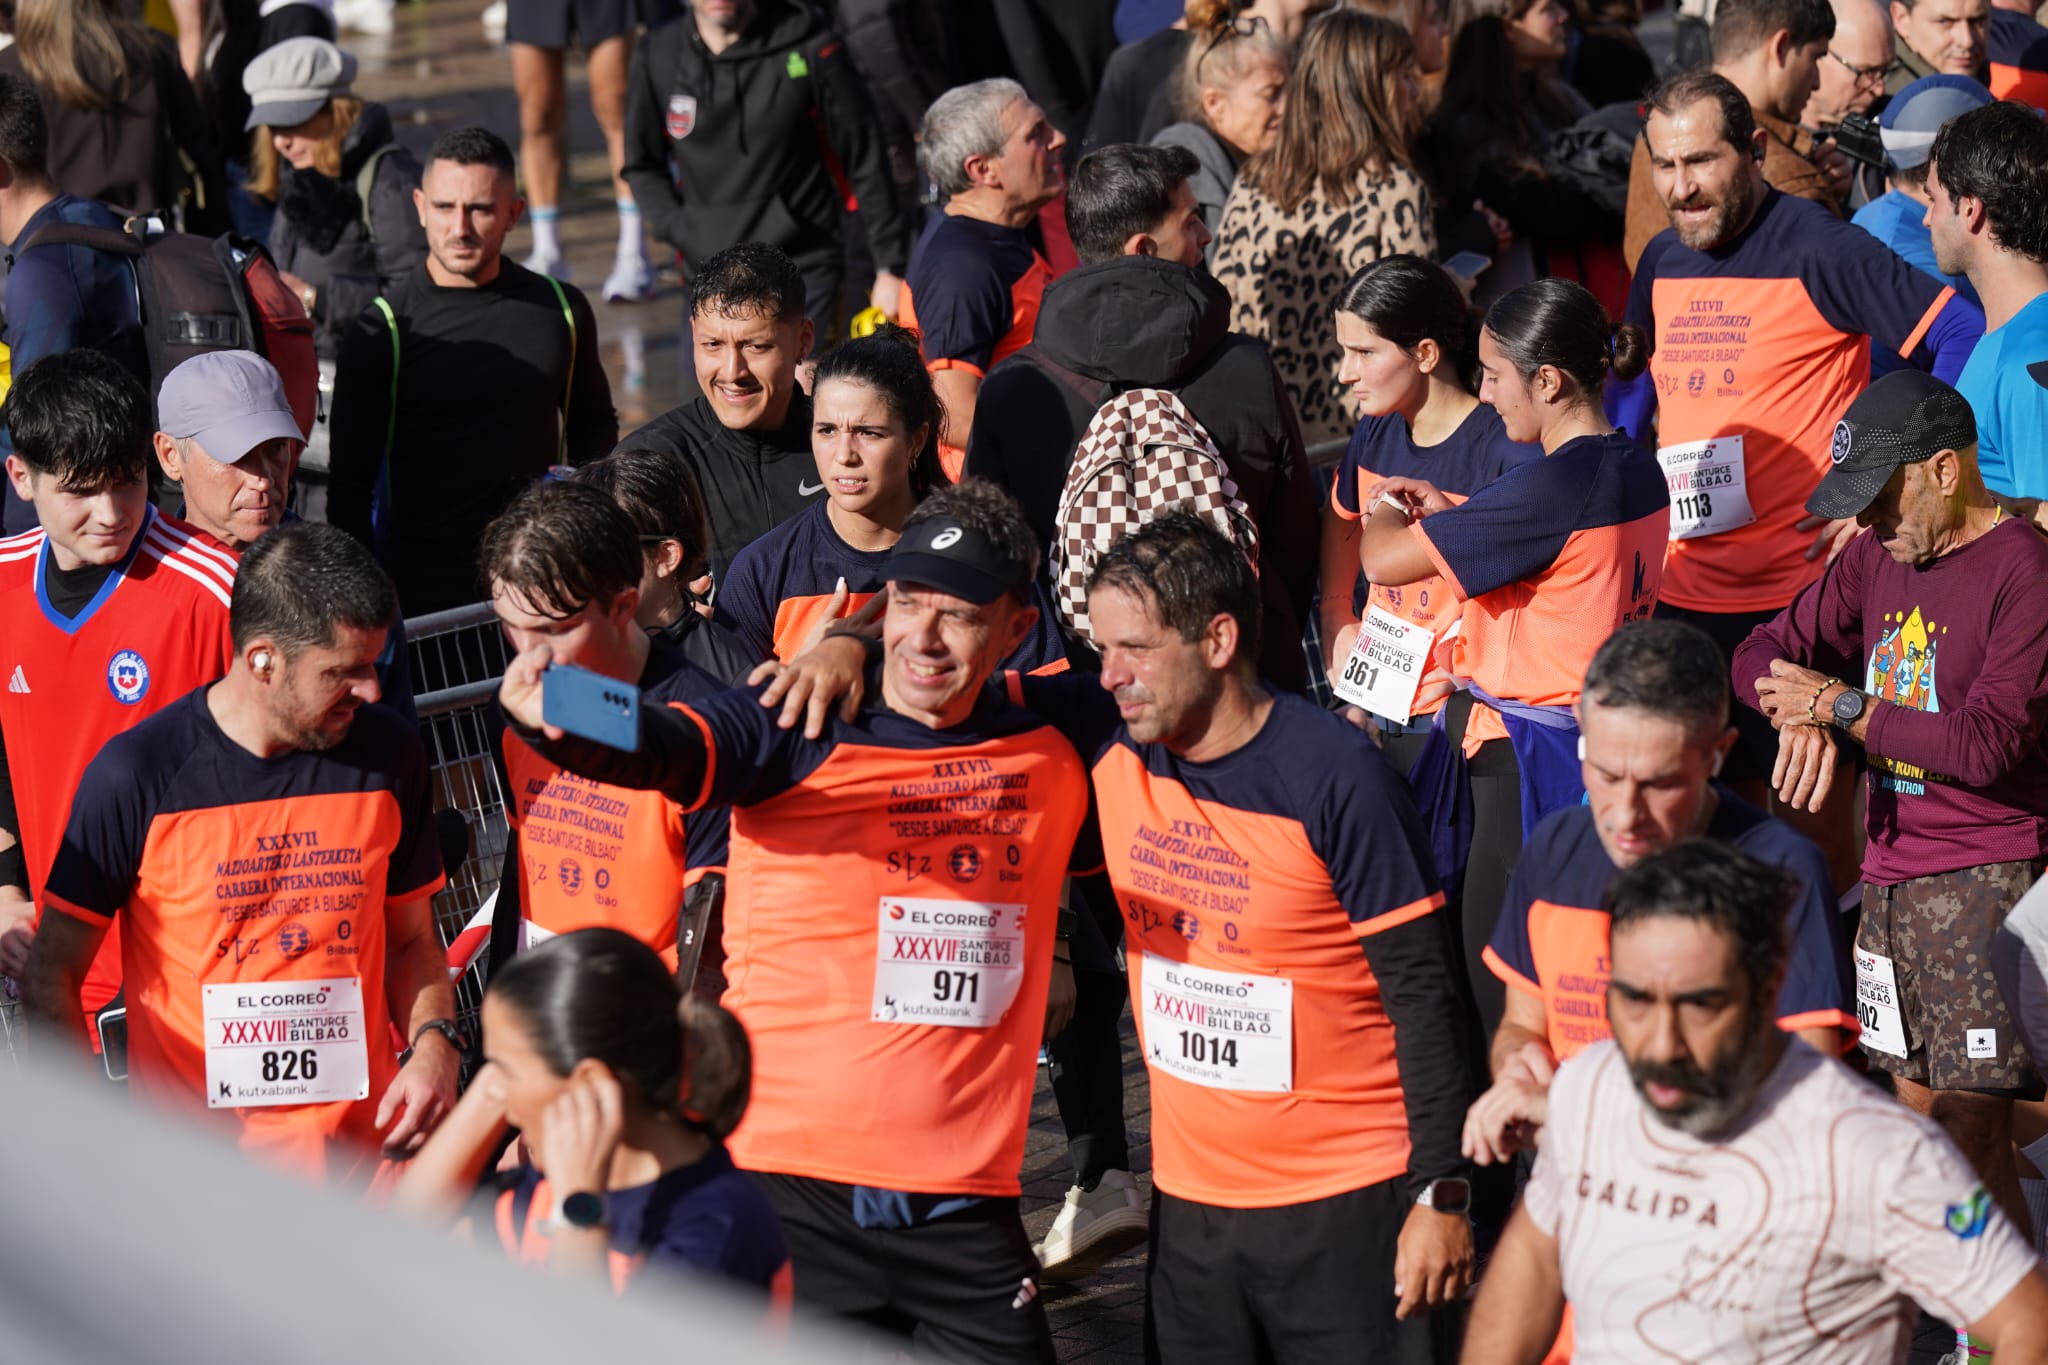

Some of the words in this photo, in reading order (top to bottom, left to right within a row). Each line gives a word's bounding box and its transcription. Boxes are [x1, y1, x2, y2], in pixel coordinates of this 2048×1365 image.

[1673, 449, 1713, 464] CORREO
[1689, 465, 1731, 479] SANTURCE
[1690, 474, 1732, 489] BILBAO
[1677, 492, 1712, 521] 1113
[1368, 615, 1404, 639] CORREO
[1368, 647, 1412, 673] BILBAO
[1371, 639, 1415, 664] SANTURCE
[1344, 656, 1379, 691] 361
[932, 759, 993, 778] XXXVII
[890, 779, 970, 799] NAZIOARTEKO
[888, 798, 942, 814] CARRERA
[944, 794, 1028, 813] INTERNACIONAL
[933, 818, 981, 836] SANTURCE
[257, 831, 318, 852] XXXVII
[215, 852, 290, 877] NAZIOARTEKO
[292, 848, 361, 868] LASTERKETA
[216, 878, 269, 899] CARRERA
[271, 870, 364, 892] INTERNACIONAL
[259, 896, 310, 918] SANTURCE
[313, 896, 320, 913] A
[911, 911, 930, 924] EL
[934, 913, 997, 927] CORREO
[893, 936, 957, 962] XXXVII
[960, 939, 1012, 951] SANTURCE
[959, 951, 1011, 964] BILBAO
[933, 970, 979, 1003] 971
[1166, 971, 1181, 985] EL
[1183, 977, 1248, 998] CORREO
[237, 996, 257, 1008] EL
[260, 992, 327, 1008] CORREO
[903, 1002, 971, 1018] kutxabank
[1154, 990, 1205, 1025] XXXVII
[1207, 1005, 1271, 1022] SANTURCE
[221, 1020, 287, 1044] XXXVII
[290, 1015, 349, 1028] SANTURCE
[290, 1027, 349, 1042] BILBAO
[1207, 1016, 1271, 1034] BILBAO
[1179, 1030, 1238, 1068] 1014
[262, 1049, 318, 1081] 826
[1165, 1056, 1222, 1080] kutxabank
[238, 1083, 309, 1098] kutxabank
[1578, 1171, 1718, 1228] GALIPA
